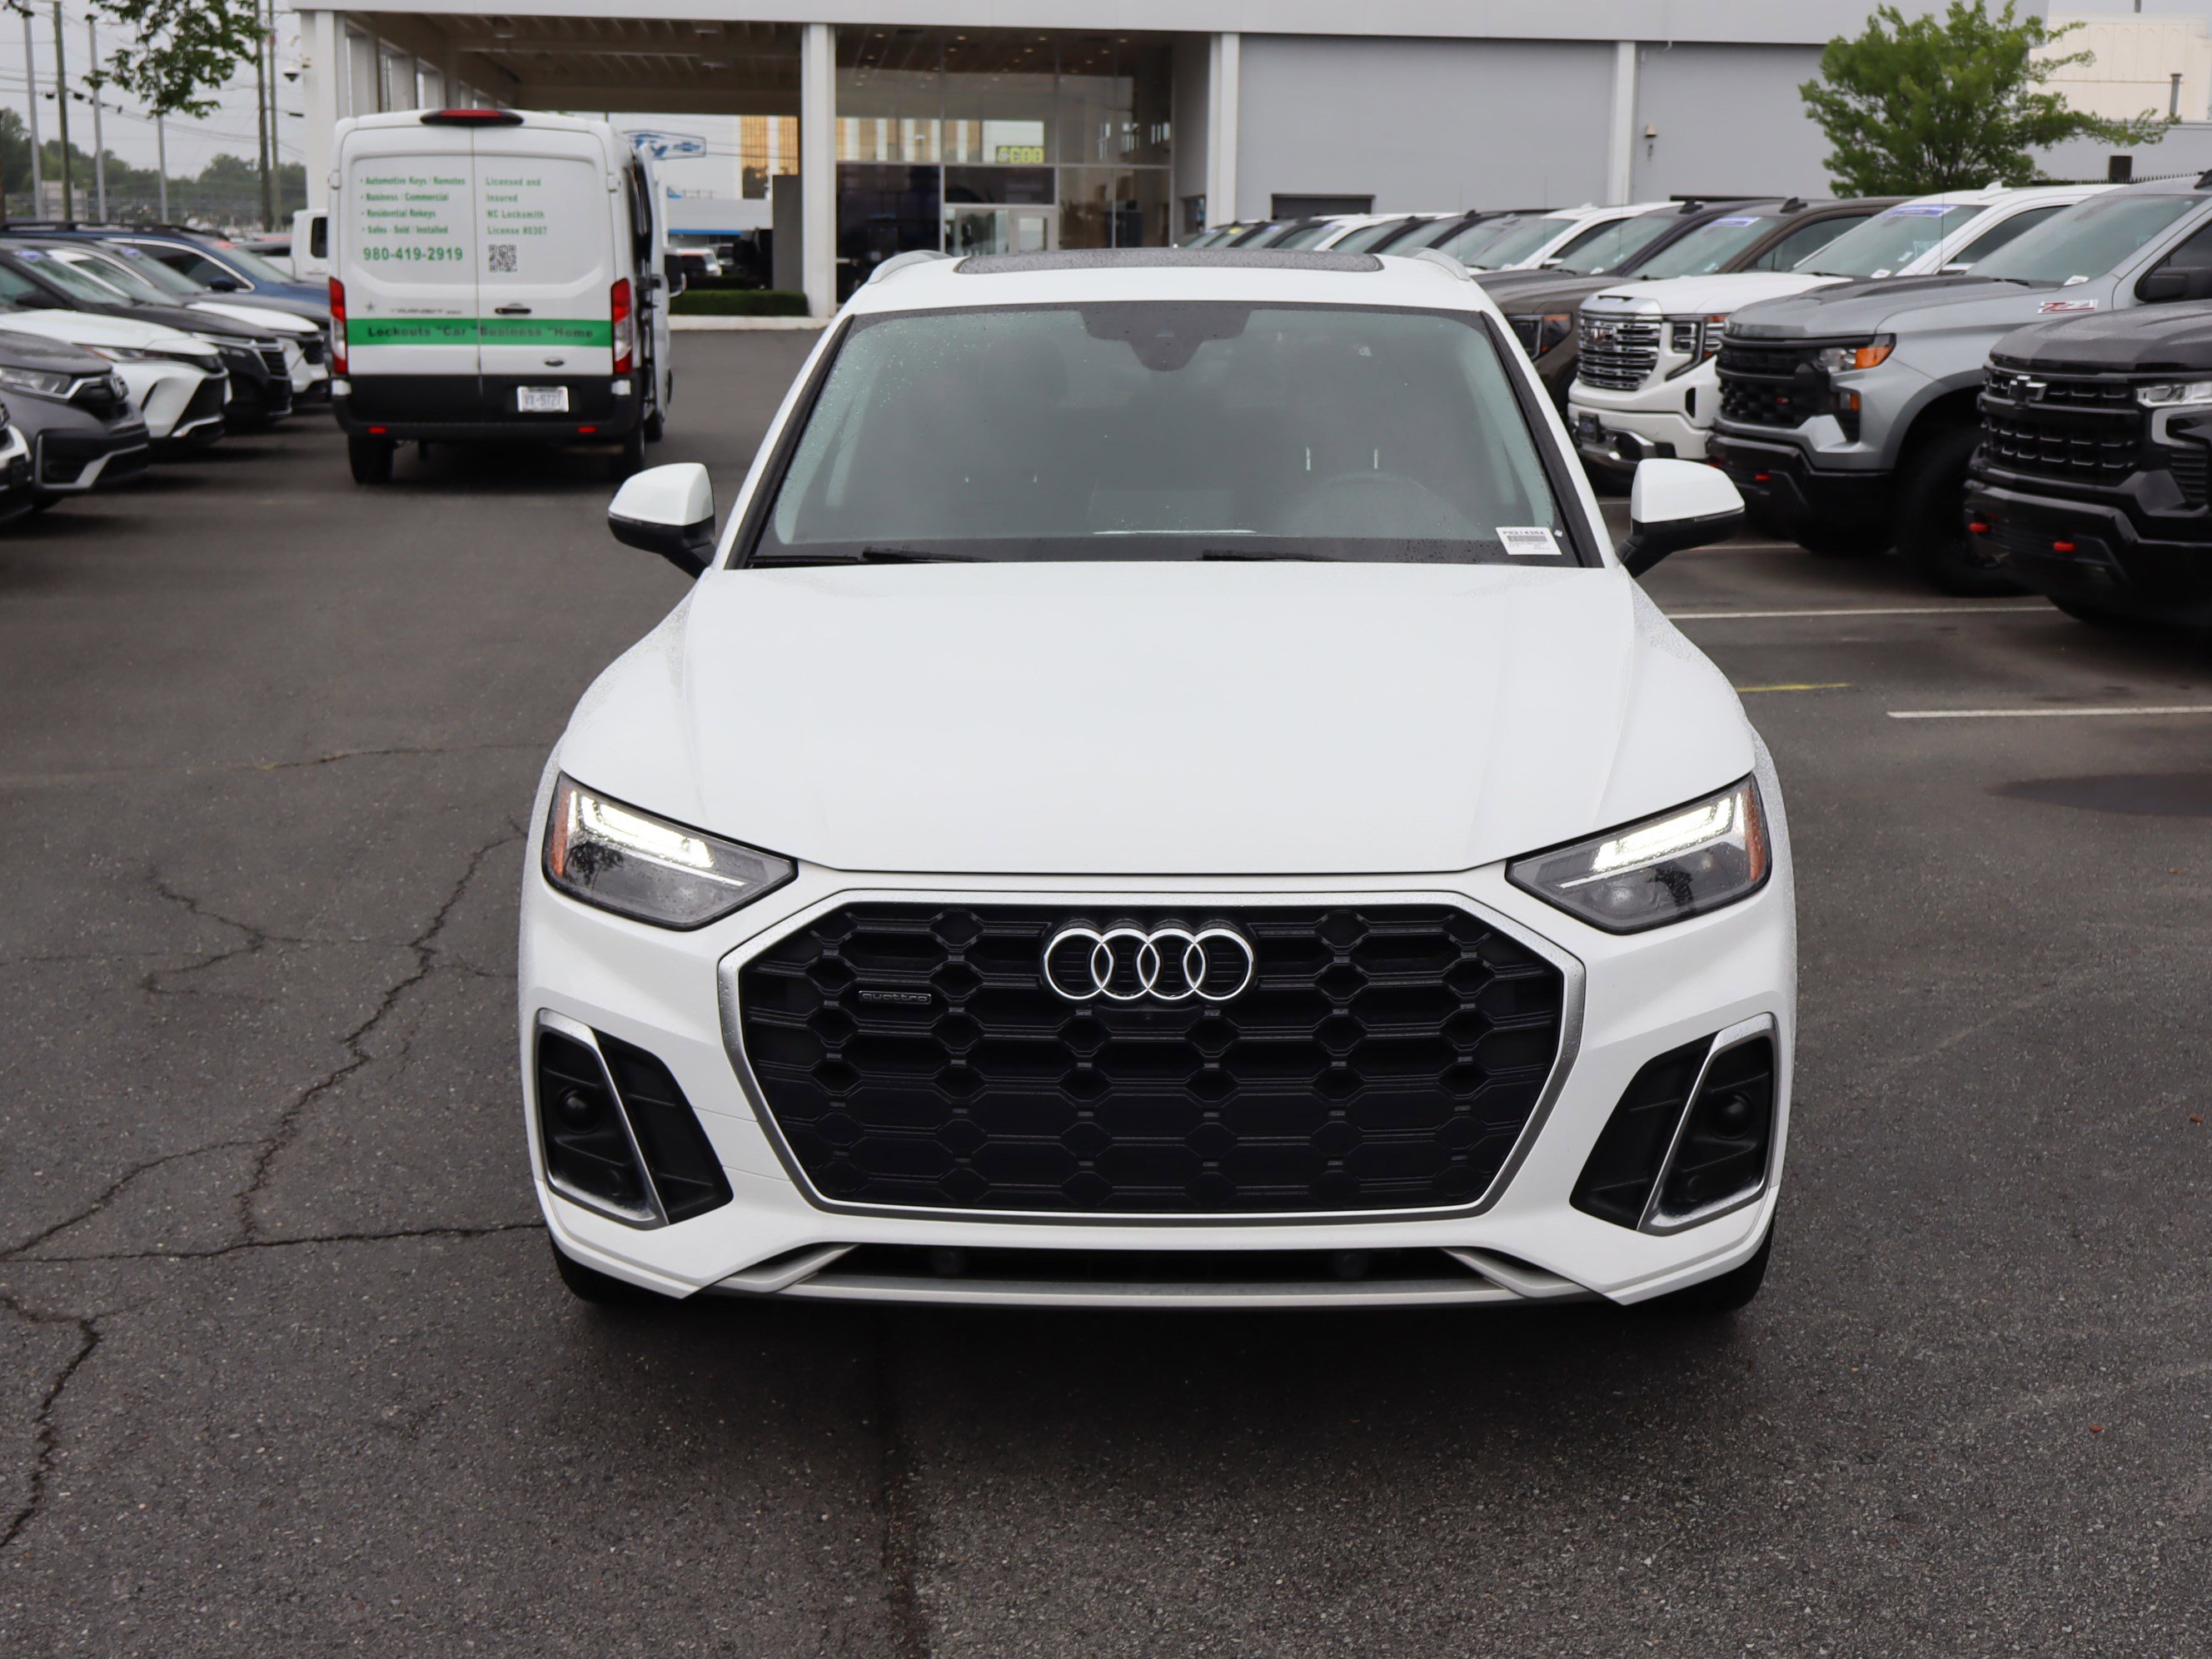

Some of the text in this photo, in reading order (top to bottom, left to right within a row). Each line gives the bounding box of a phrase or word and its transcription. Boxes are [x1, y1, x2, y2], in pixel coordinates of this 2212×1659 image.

[366, 176, 466, 187] Automotive Keys Remotes
[486, 177, 541, 187] Licensed and
[366, 192, 449, 201] Business Commercial
[486, 193, 518, 202] Insured
[366, 209, 407, 217] Residential
[487, 209, 545, 219] NC Locksmith
[367, 226, 387, 234] Sales
[416, 226, 449, 234] Installed
[487, 227, 520, 235] License
[363, 247, 463, 261] 980-419-2919
[367, 326, 431, 337] Lockouts
[862, 994, 928, 1002] quattro
